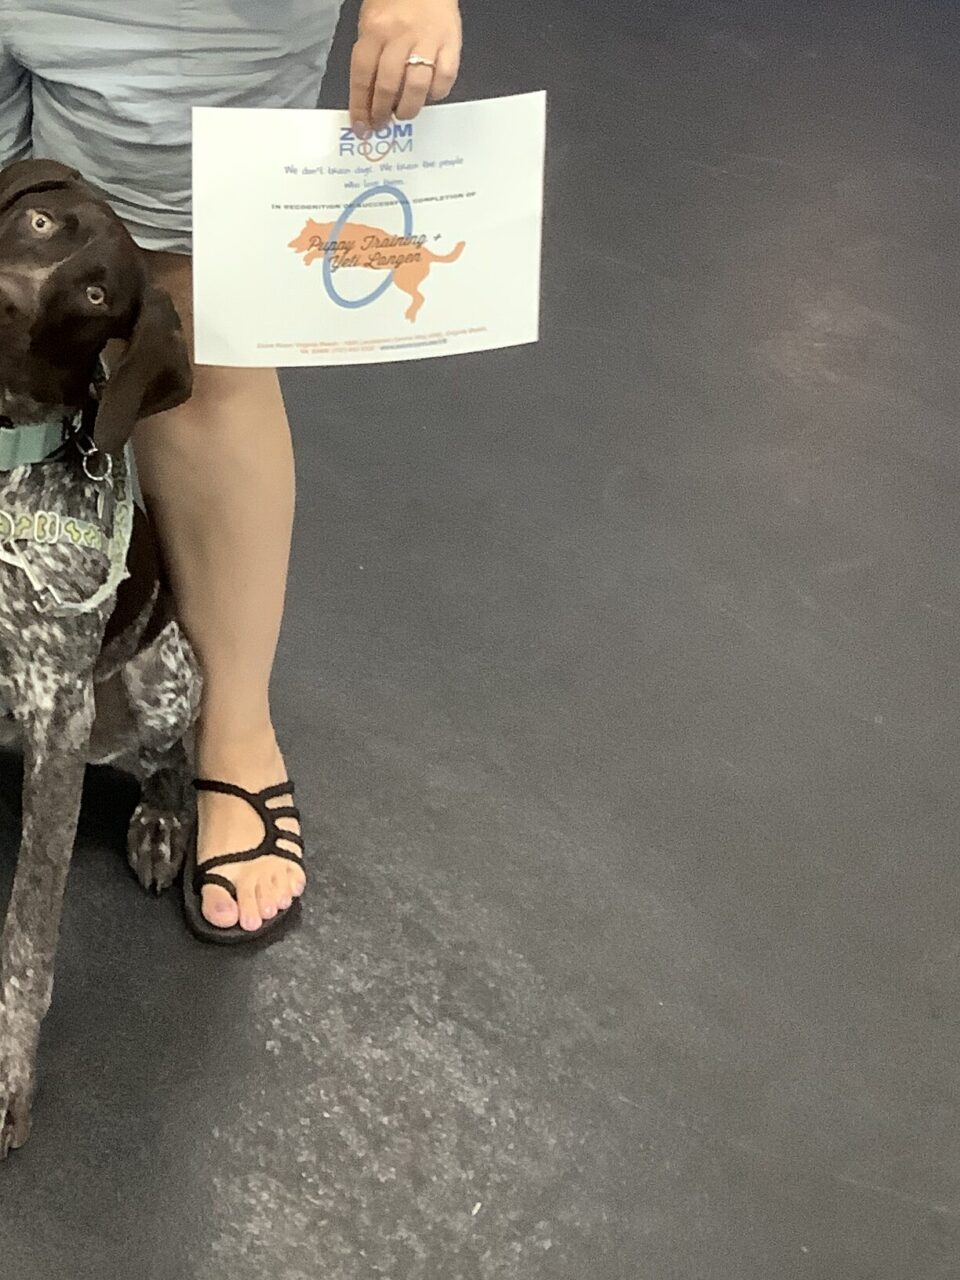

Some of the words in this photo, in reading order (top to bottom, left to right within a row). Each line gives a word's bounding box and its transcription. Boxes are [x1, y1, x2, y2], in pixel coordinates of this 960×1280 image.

[339, 138, 413, 157] ROOM
[306, 234, 357, 255] Puppy
[360, 233, 427, 250] Training
